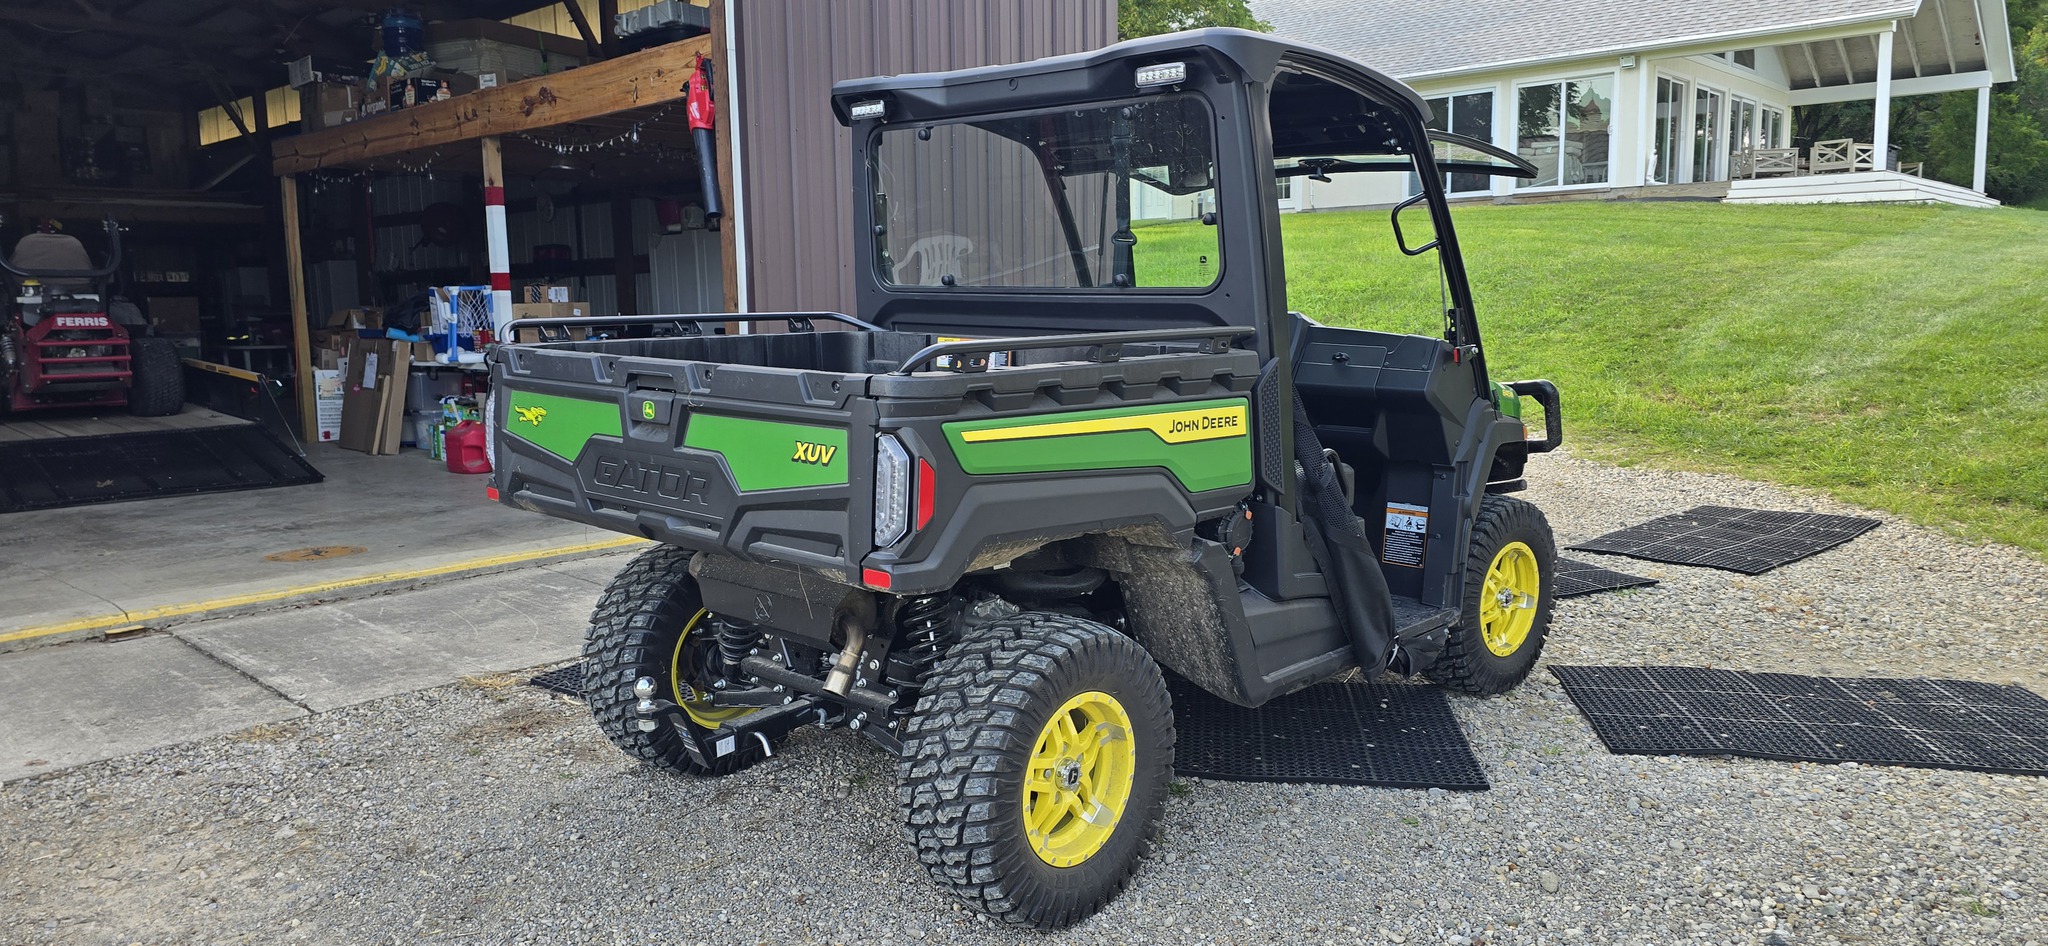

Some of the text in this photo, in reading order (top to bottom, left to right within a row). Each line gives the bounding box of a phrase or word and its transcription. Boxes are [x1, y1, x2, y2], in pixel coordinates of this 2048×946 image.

[56, 317, 109, 327] FERRIS
[1169, 415, 1238, 433] JOHN DEERE
[791, 440, 838, 467] XUV
[594, 455, 711, 506] GATOR
